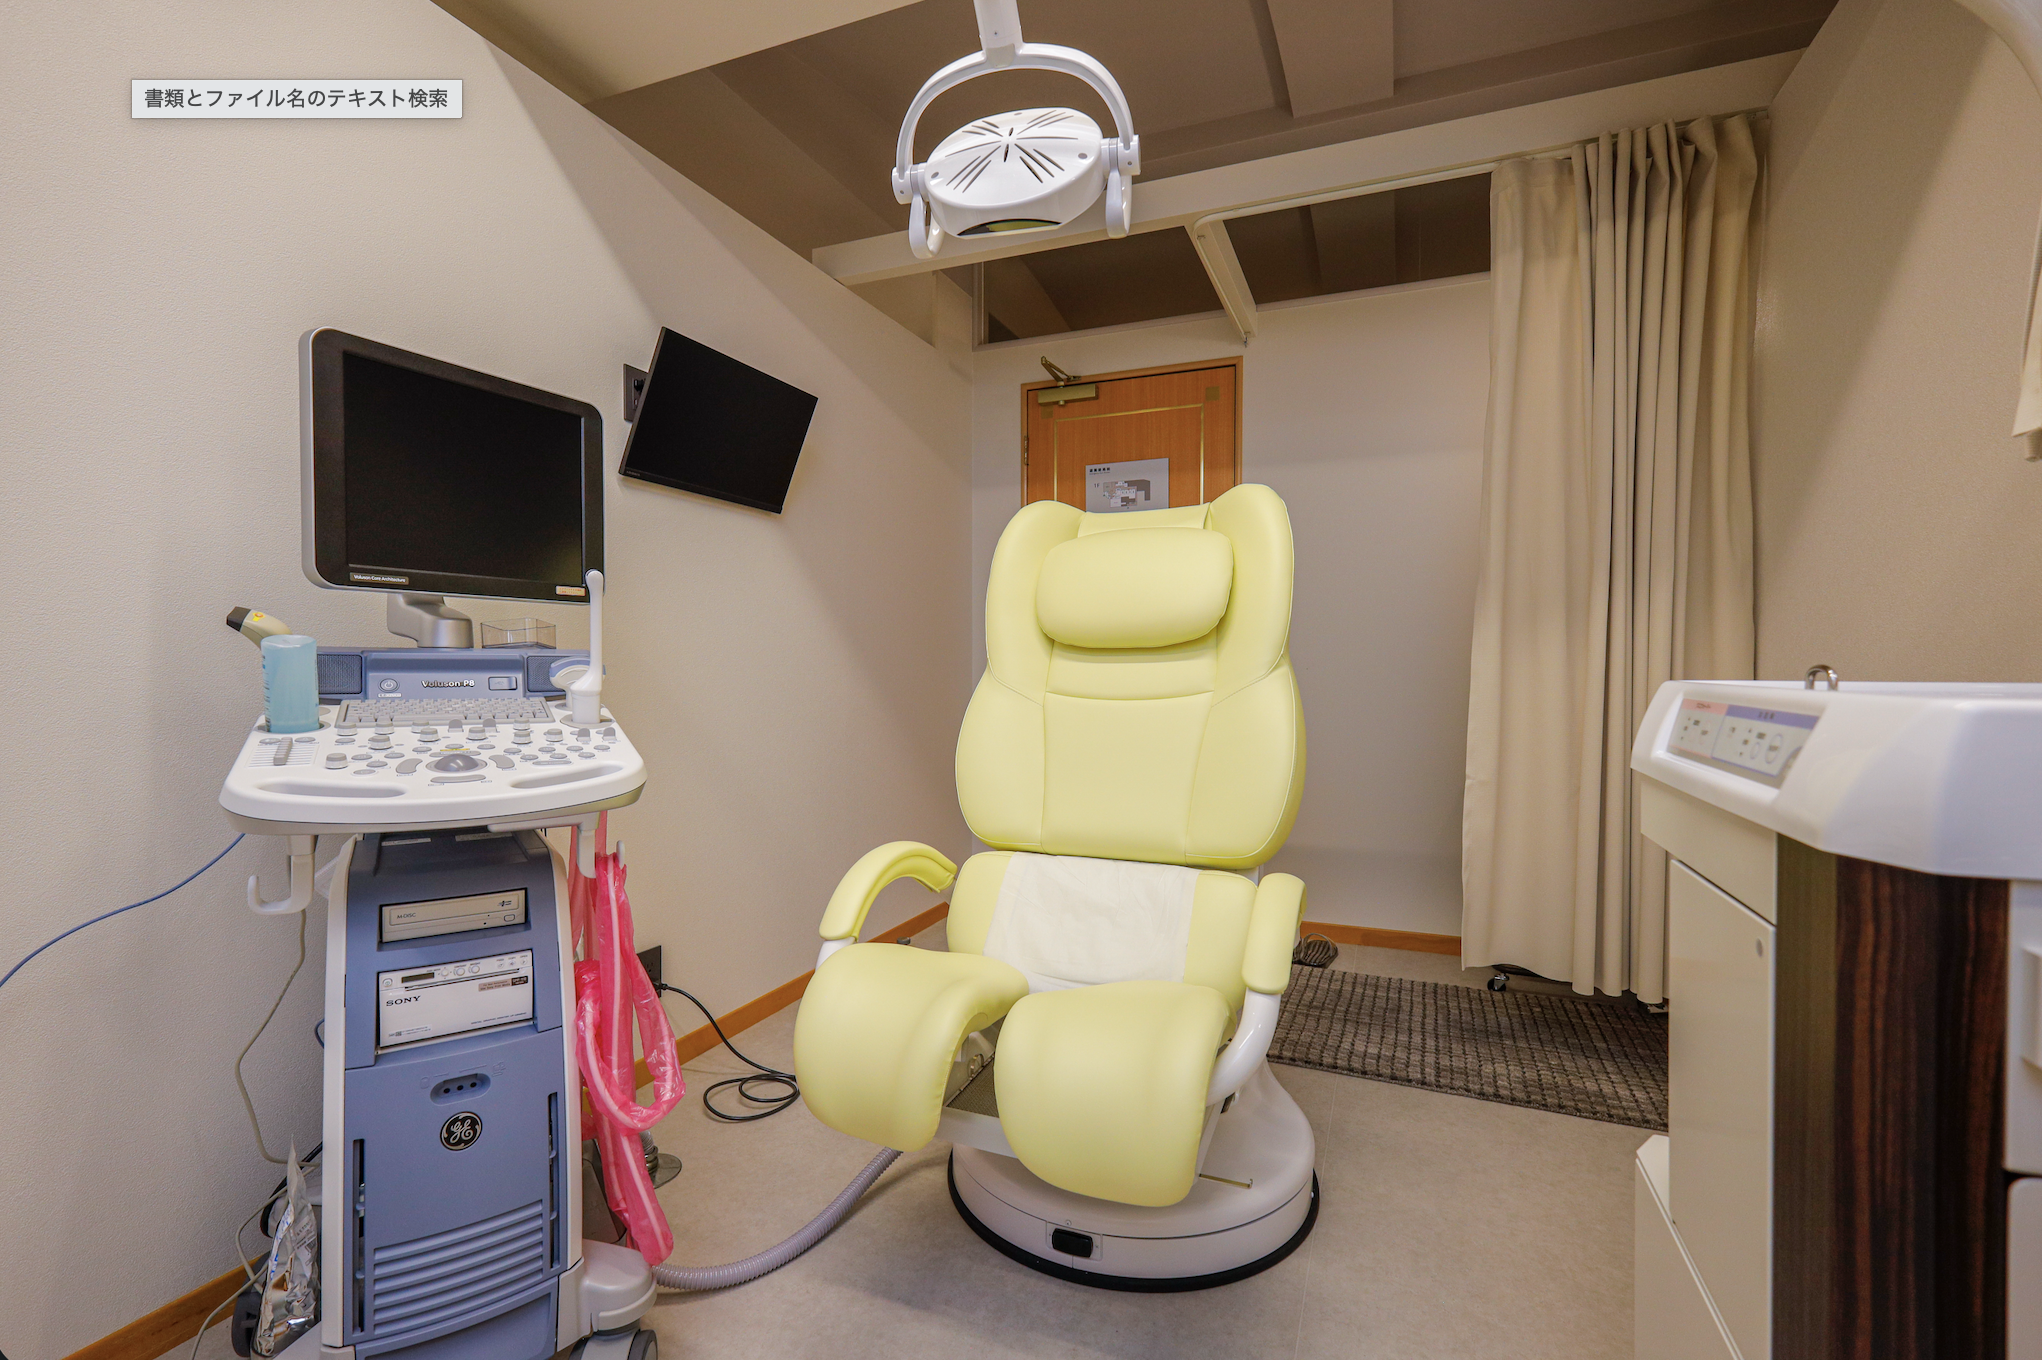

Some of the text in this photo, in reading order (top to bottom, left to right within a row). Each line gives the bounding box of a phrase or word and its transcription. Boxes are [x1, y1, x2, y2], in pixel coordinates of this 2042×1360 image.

[421, 679, 475, 689] Voluson P8
[386, 995, 421, 1006] SONY
